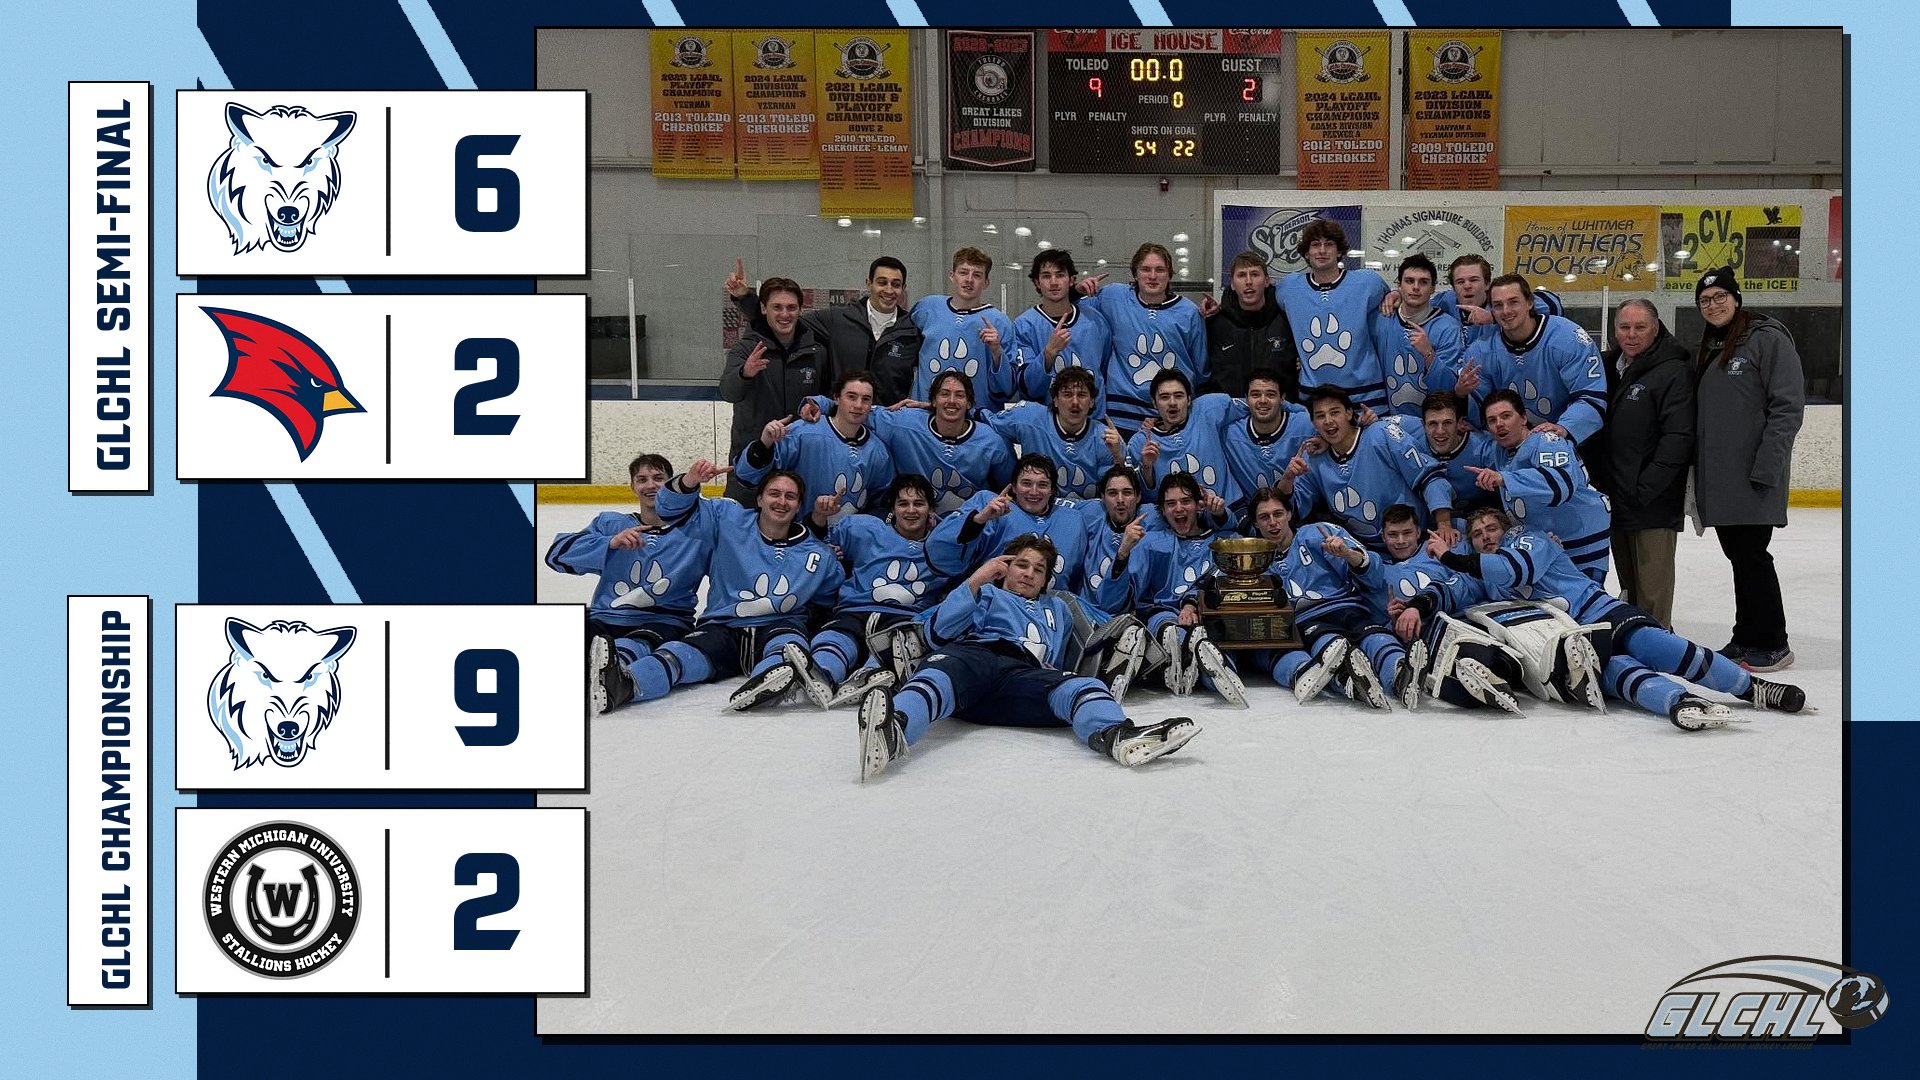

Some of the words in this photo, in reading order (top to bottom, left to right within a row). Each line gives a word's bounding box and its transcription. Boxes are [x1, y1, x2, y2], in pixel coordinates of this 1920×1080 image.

[1110, 32, 1142, 50] ICE
[1153, 31, 1218, 51] HOUSE
[1066, 58, 1109, 71] TOLEDO
[1131, 58, 1183, 81] 00.0
[1221, 58, 1262, 72] GUEST
[825, 82, 856, 91] 2021
[1089, 78, 1102, 98] 9
[1243, 79, 1256, 101] 2
[662, 89, 722, 97] CHAMPIONS
[746, 90, 806, 98] CHAMPIONS
[828, 93, 886, 102] DIVISION
[1304, 92, 1336, 102] 2024
[1138, 95, 1169, 104] PERIOD
[1173, 92, 1184, 108] 0
[836, 103, 893, 112] PLAYOFF
[1315, 102, 1371, 111] PLAYOFF
[1425, 101, 1482, 109] DIVISION
[655, 112, 681, 122] 2013
[685, 112, 731, 122] TOLEDO
[962, 107, 990, 117] GREAT
[993, 107, 1022, 117] LAKES
[1054, 112, 1077, 121] PLYR
[1088, 112, 1127, 121] PENALTY
[1306, 112, 1380, 121] CHAMPIONS
[1415, 110, 1491, 120] CHAMPIONS
[738, 114, 766, 123] 2013
[769, 114, 816, 123] TOLEDO
[826, 113, 903, 122] CHAMPIONS
[973, 118, 1011, 127] DIVISION
[1204, 113, 1226, 122] PLYR
[1238, 113, 1277, 122] PENALTY
[662, 123, 724, 132] CHEROKEE
[746, 124, 810, 133] CHEROKEE
[848, 124, 875, 132] HOWE
[877, 124, 884, 132] 2
[1131, 126, 1159, 135] SHOTS
[1160, 126, 1173, 135] ON
[1174, 126, 1196, 135] GOAL
[1310, 122, 1338, 130] ADAMS
[1339, 122, 1373, 130] DIVISION
[834, 135, 856, 143] 2010
[858, 135, 896, 143] TOLEDO
[953, 129, 1031, 152] CHAMPIONS
[821, 144, 871, 152] CHEROKEE
[877, 144, 909, 152] LEMAY
[1134, 140, 1157, 156] 54
[1173, 140, 1195, 157] 22
[1302, 140, 1331, 150] 2012
[1334, 140, 1383, 150] TOLEDO
[1411, 142, 1442, 153] 2009
[1445, 142, 1494, 153] TOLEDO
[1310, 153, 1376, 163] CHEROKEE
[1421, 154, 1488, 164] CHEROKEE
[1378, 216, 1412, 243] THOMAS
[1412, 210, 1463, 226] SIGNATURE
[1461, 219, 1494, 252] BUILDERS
[1525, 220, 1553, 231] Home
[1557, 222, 1568, 236] of
[1572, 219, 1635, 231] WHITMER
[1699, 209, 1732, 243] CV
[1515, 233, 1644, 253] PANTHERS
[1682, 232, 1699, 270] 2
[1727, 231, 1744, 270] 3
[1514, 255, 1616, 275] HOCKEY
[1663, 281, 1693, 290] eave
[1745, 280, 1763, 290] the
[1767, 280, 1787, 290] ICE
[1539, 452, 1570, 468] 56
[1299, 545, 1313, 566] C
[805, 552, 821, 573] C
[1043, 607, 1057, 632] A
